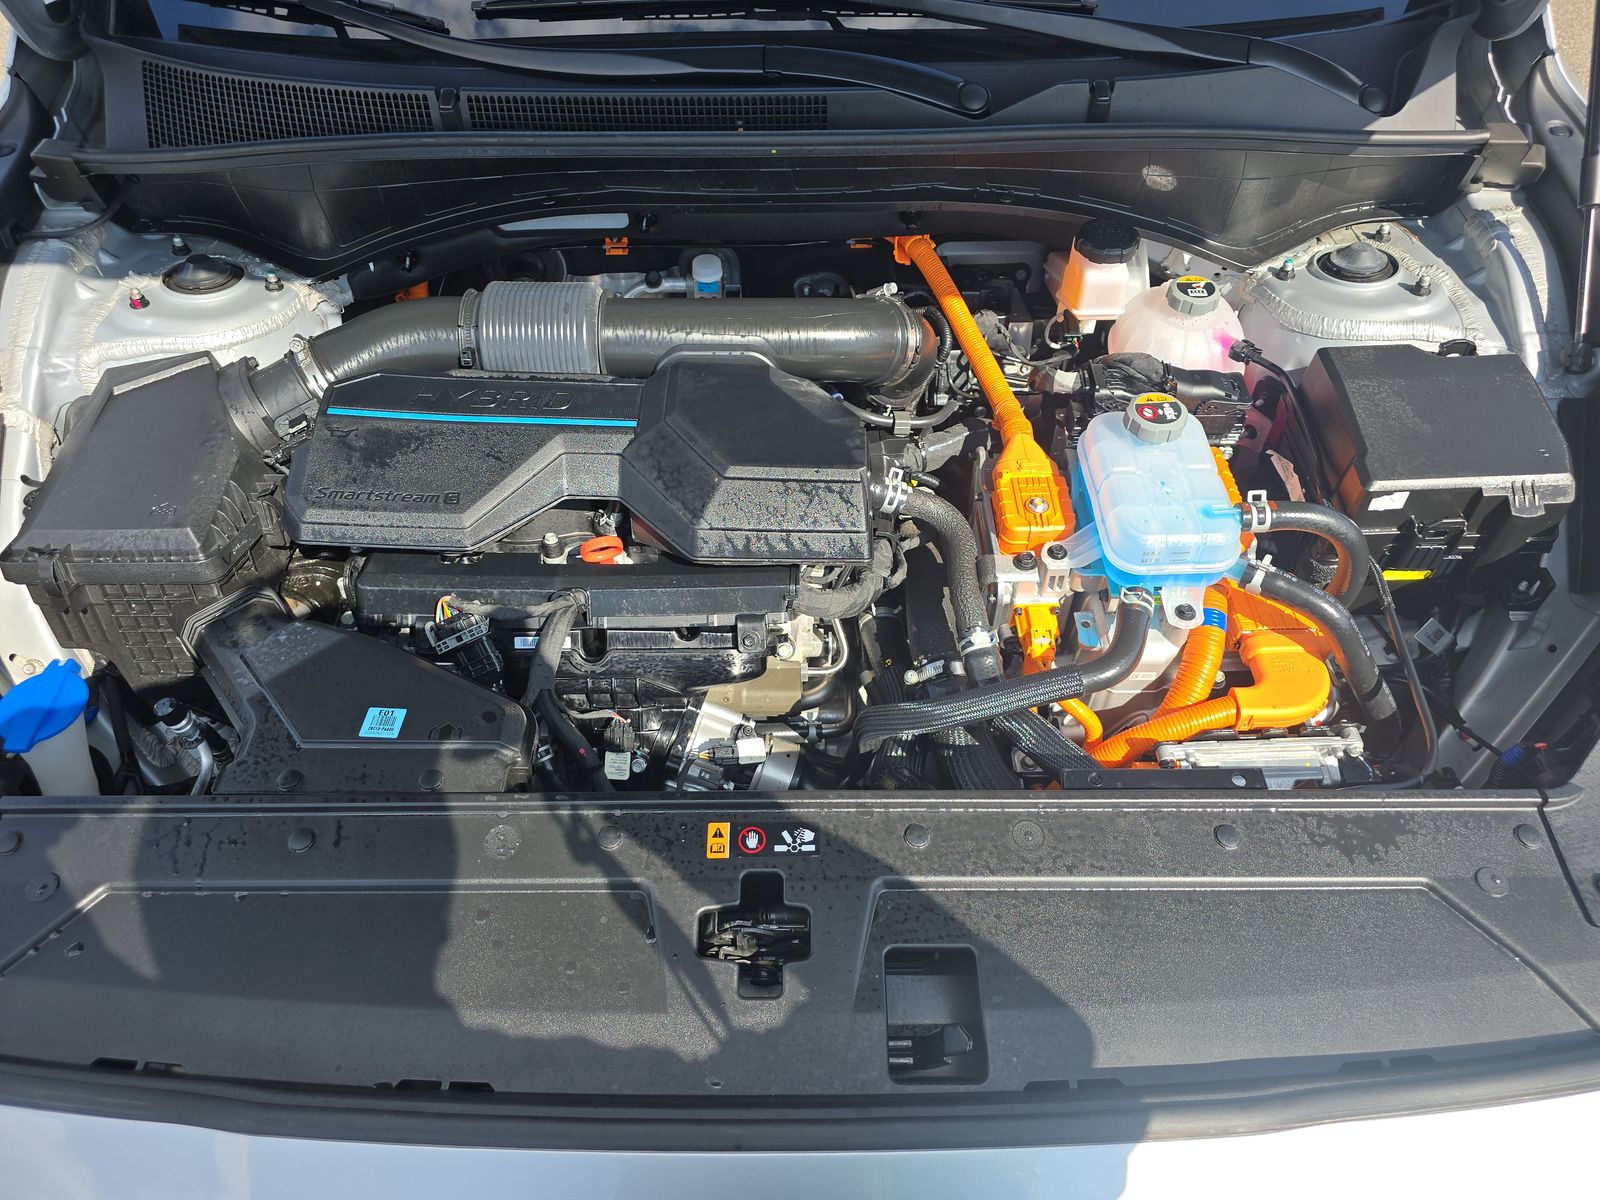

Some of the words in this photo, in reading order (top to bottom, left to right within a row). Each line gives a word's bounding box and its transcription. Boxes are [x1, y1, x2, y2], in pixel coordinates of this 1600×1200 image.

[409, 387, 575, 410] HYBRID
[314, 487, 440, 504] Smartstream
[378, 709, 395, 717] E01
